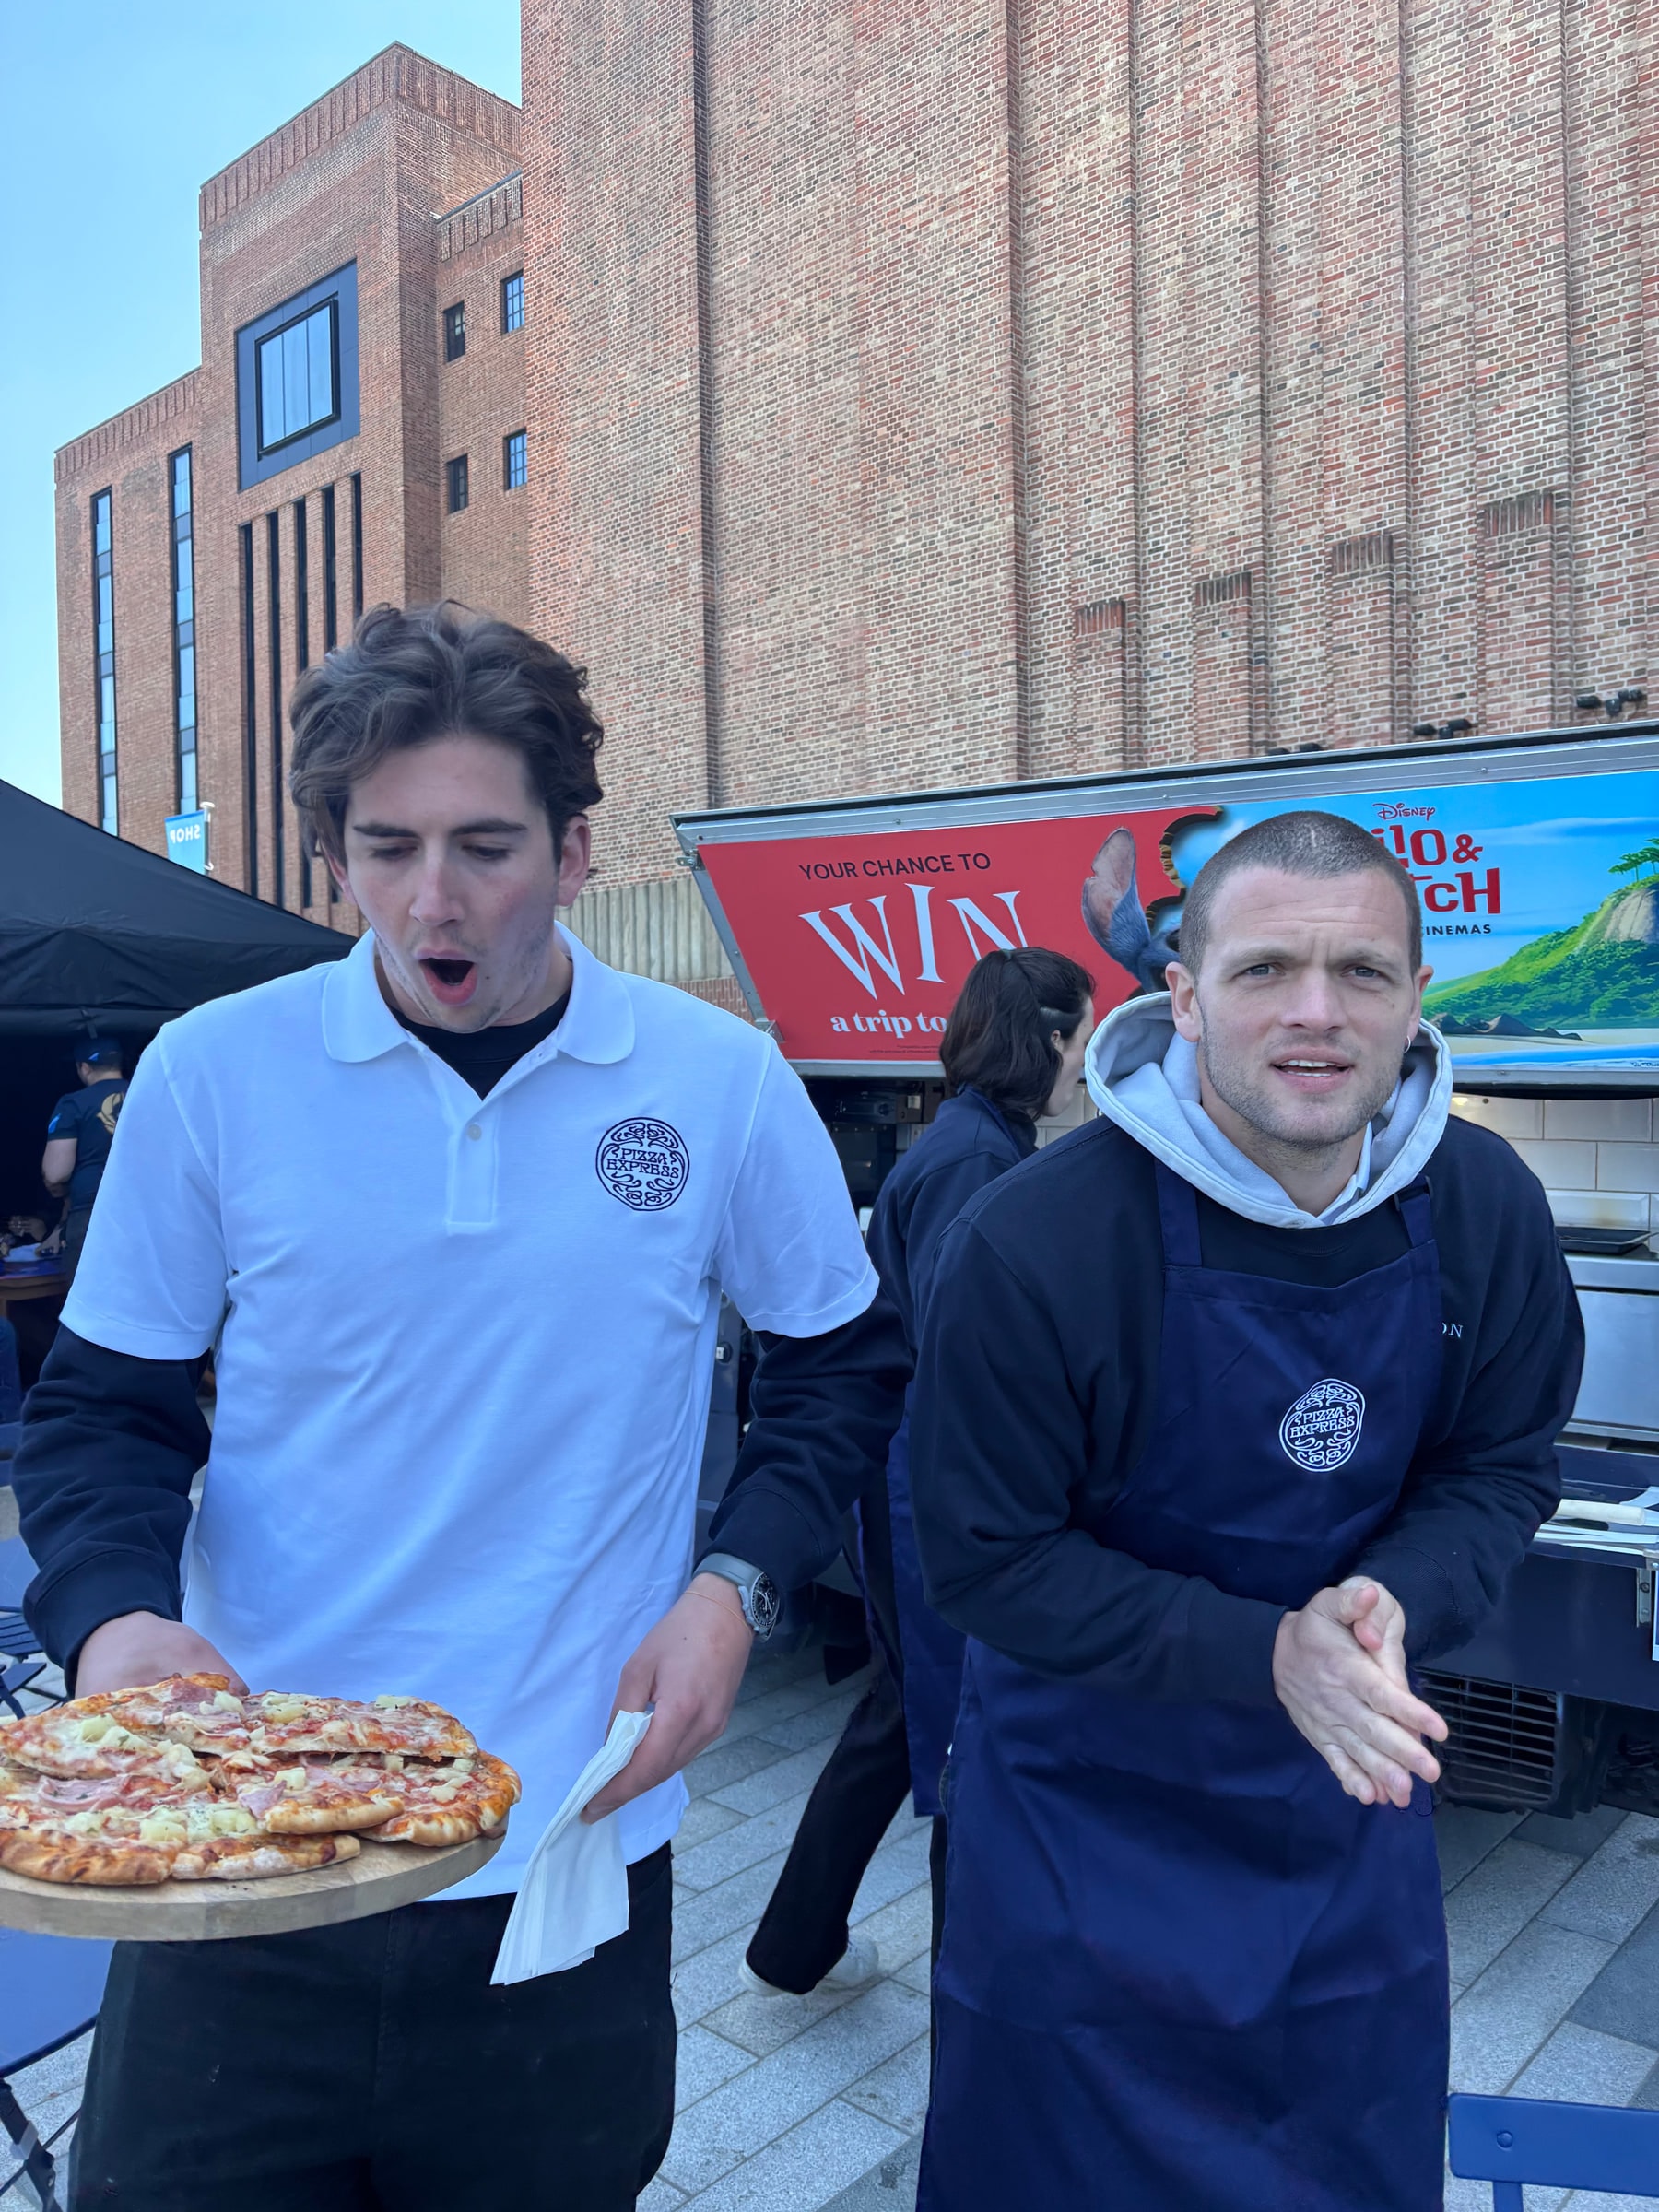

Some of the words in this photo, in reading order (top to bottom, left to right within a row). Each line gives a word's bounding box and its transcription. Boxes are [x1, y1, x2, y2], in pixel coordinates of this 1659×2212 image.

[1372, 803, 1436, 821] Disney
[1452, 834, 1483, 864] &
[799, 862, 858, 880] YOUR
[862, 855, 955, 877] CHANCE
[958, 853, 991, 870] TO
[1422, 924, 1491, 935] INEMAS
[798, 883, 1028, 1000] WIN
[830, 1016, 851, 1032] a
[853, 1009, 912, 1039] trip
[916, 1012, 947, 1033] to
[620, 1148, 668, 1165] PIZZA
[606, 1159, 679, 1179] EXPRESS
[1303, 1406, 1345, 1424] PIZZA
[1290, 1416, 1355, 1438] EXPRESS
